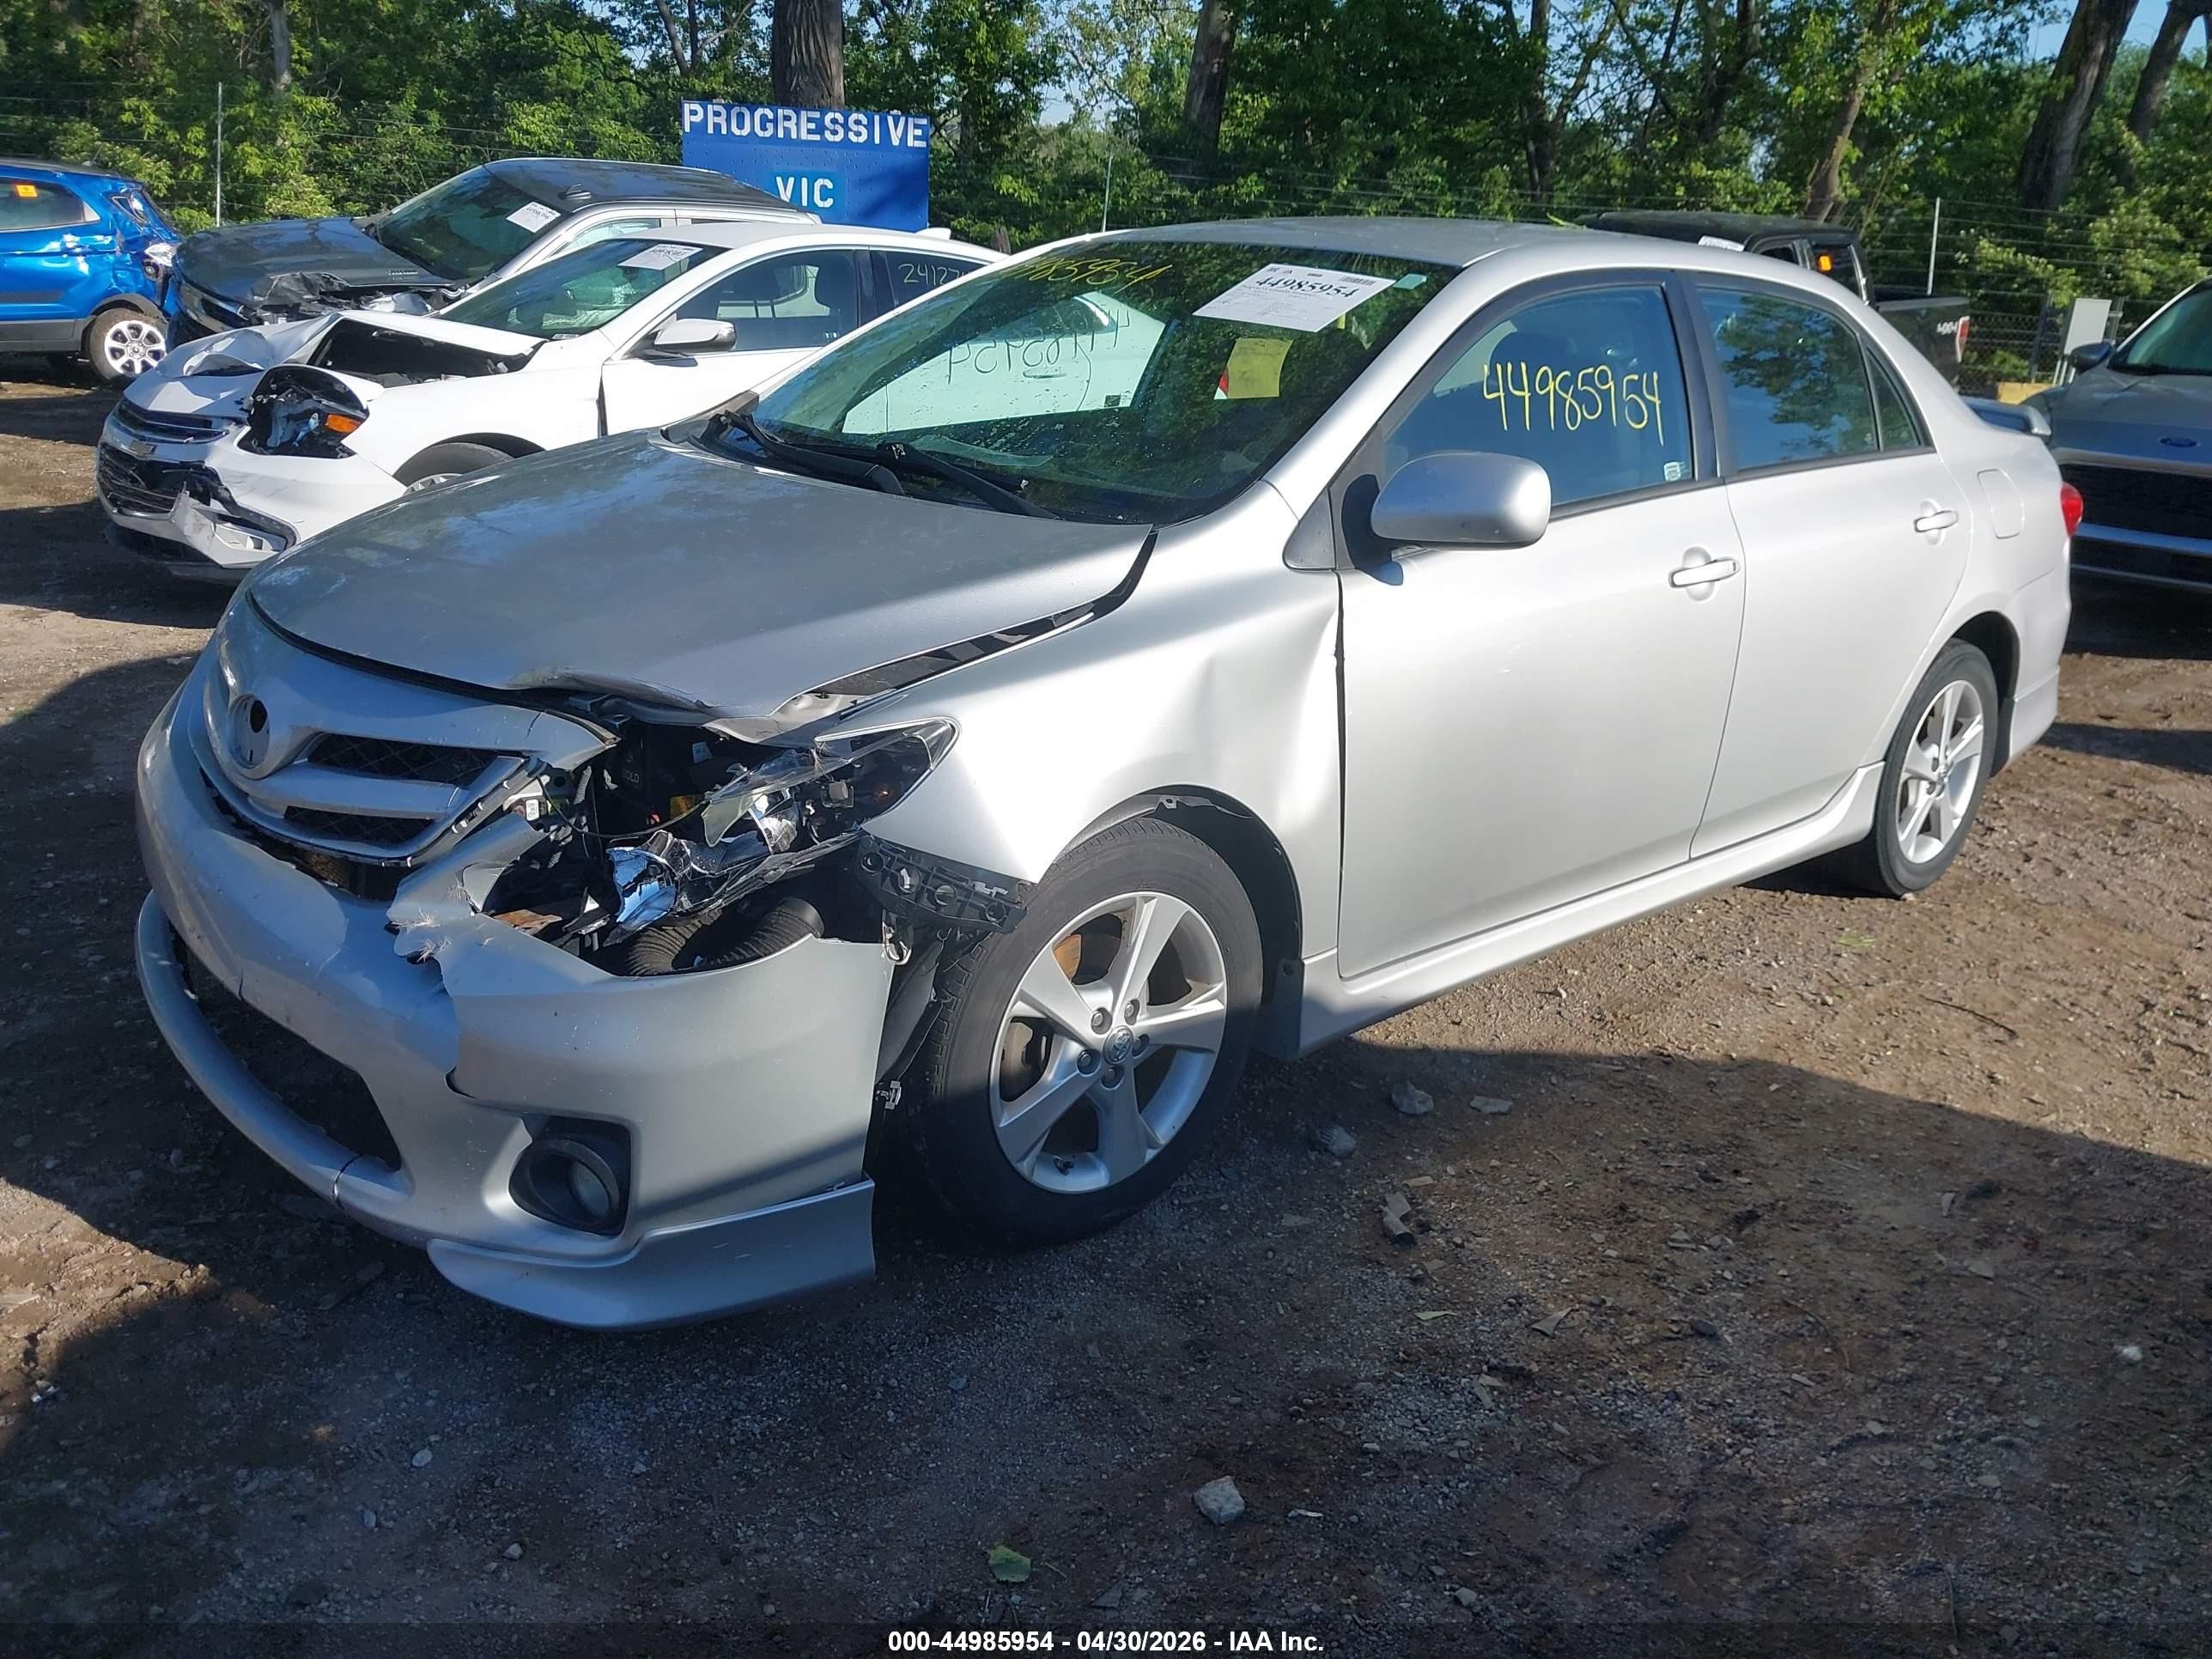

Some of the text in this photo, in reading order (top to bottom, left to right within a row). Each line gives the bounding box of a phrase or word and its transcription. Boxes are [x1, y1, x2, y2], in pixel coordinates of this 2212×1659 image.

[684, 103, 927, 149] PROGRESSIVE
[775, 176, 834, 208] VIC
[1255, 276, 1360, 298] 44985954
[1483, 361, 1665, 447] 44985954
